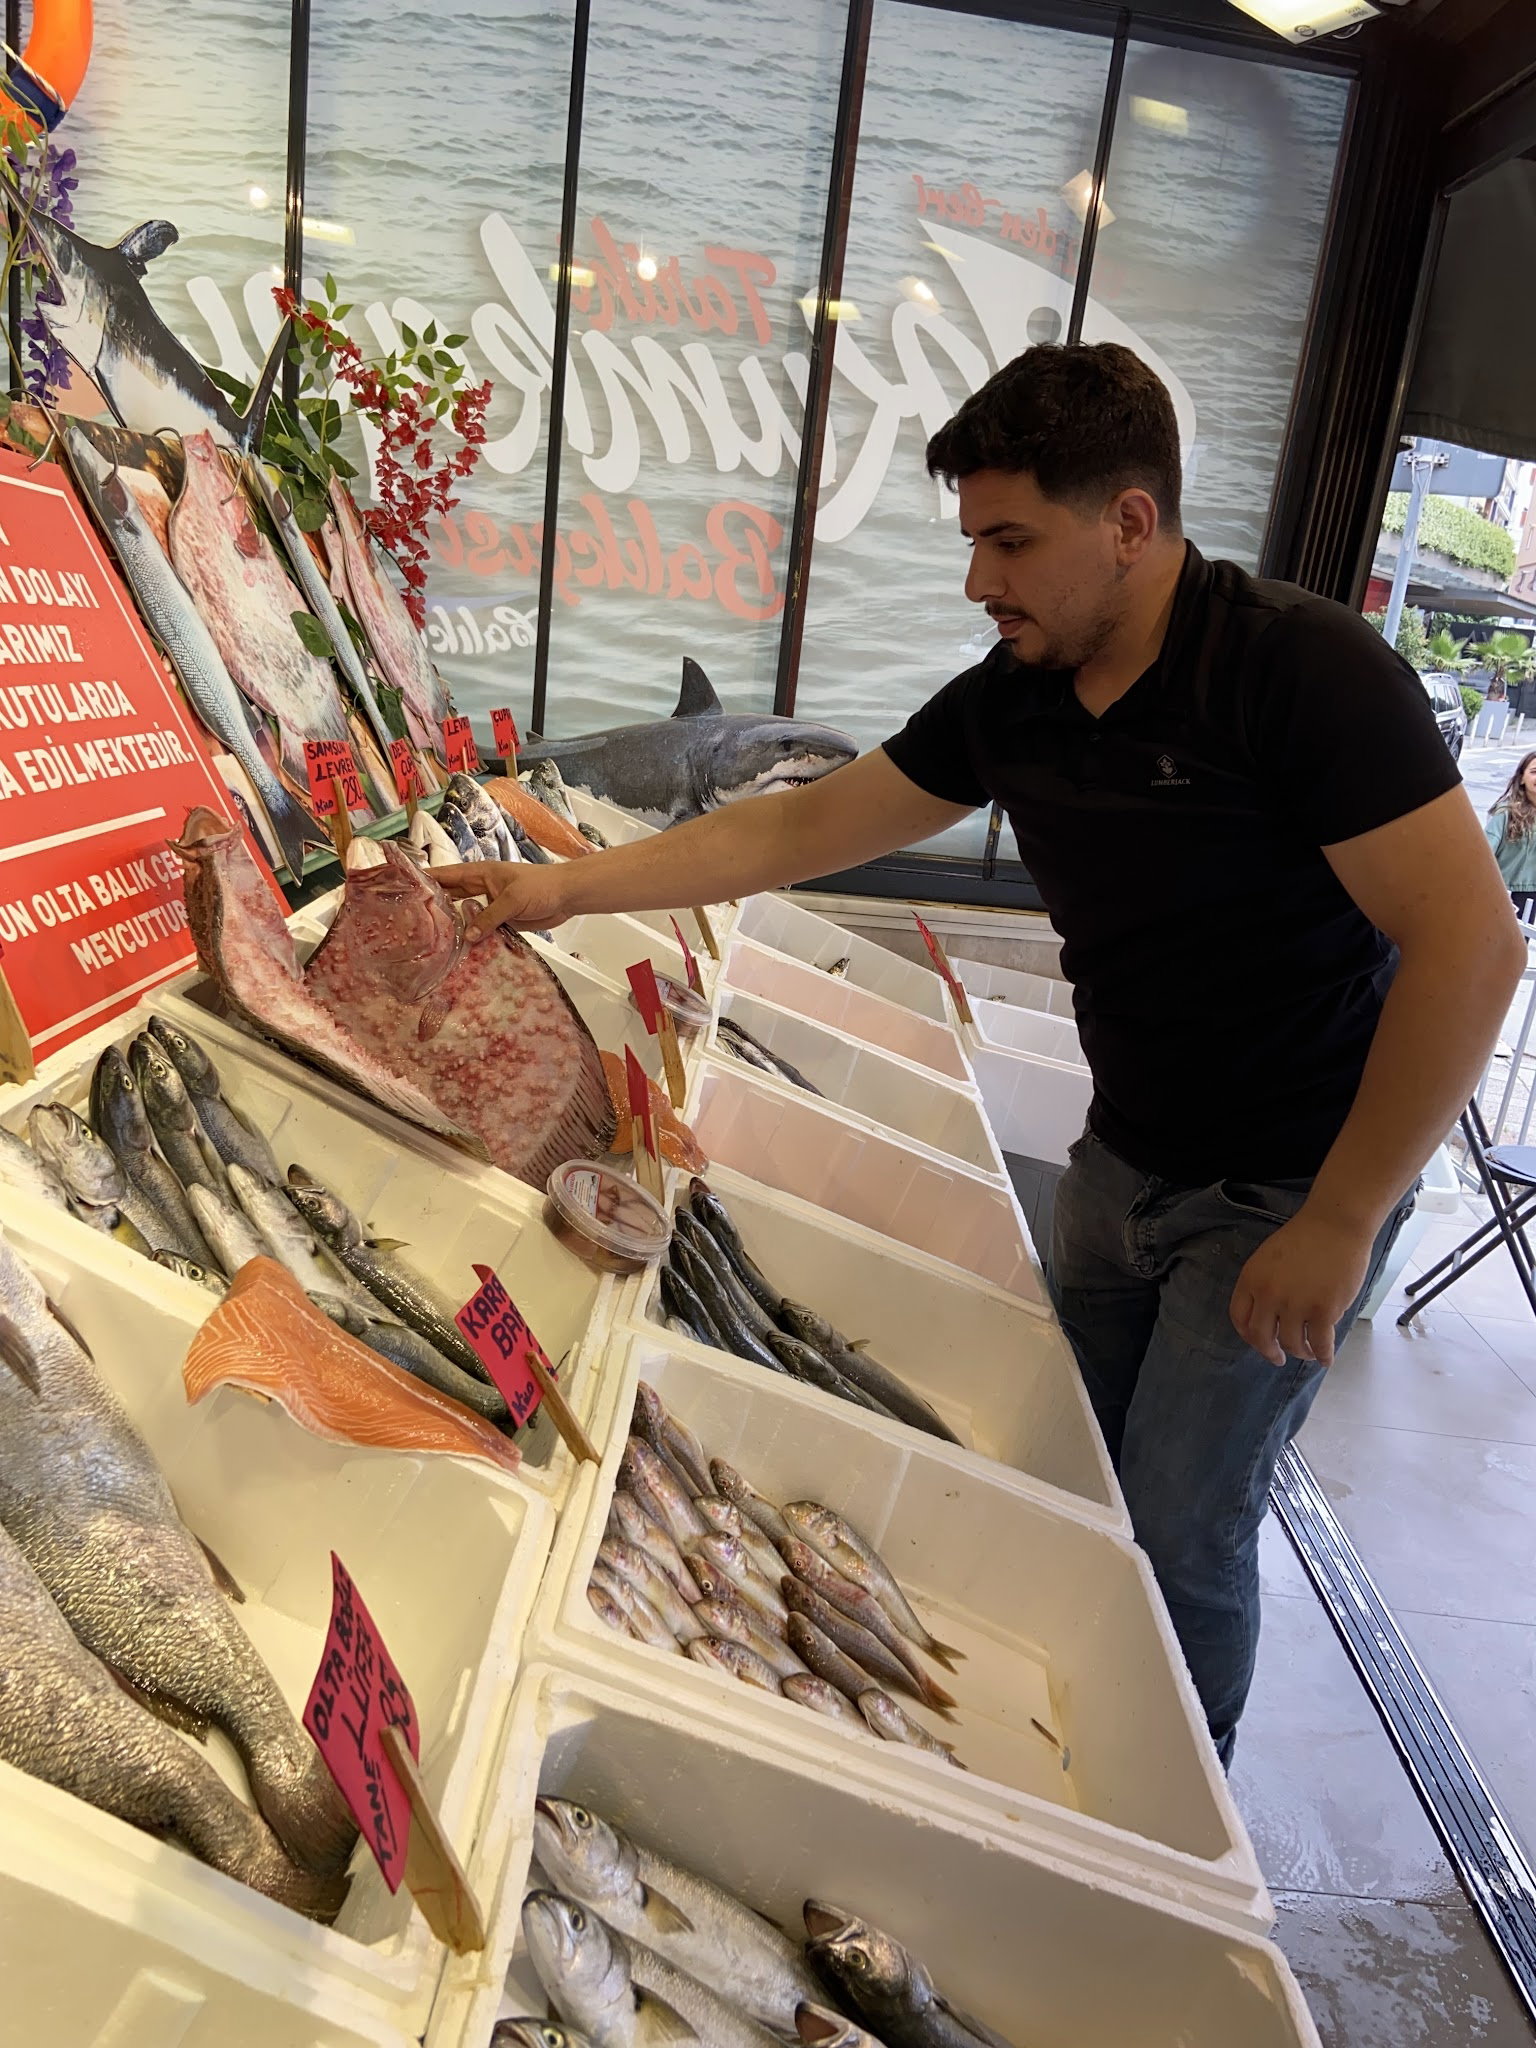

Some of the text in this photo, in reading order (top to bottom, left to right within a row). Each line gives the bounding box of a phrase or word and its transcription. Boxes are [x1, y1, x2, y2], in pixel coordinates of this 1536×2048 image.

[8, 565, 101, 609] DOLAYI
[13, 721, 195, 793] EDİLMEKTEDİR.
[31, 881, 98, 927] OLTA
[87, 858, 157, 907] BALIK
[313, 1648, 346, 1741] OLTA
